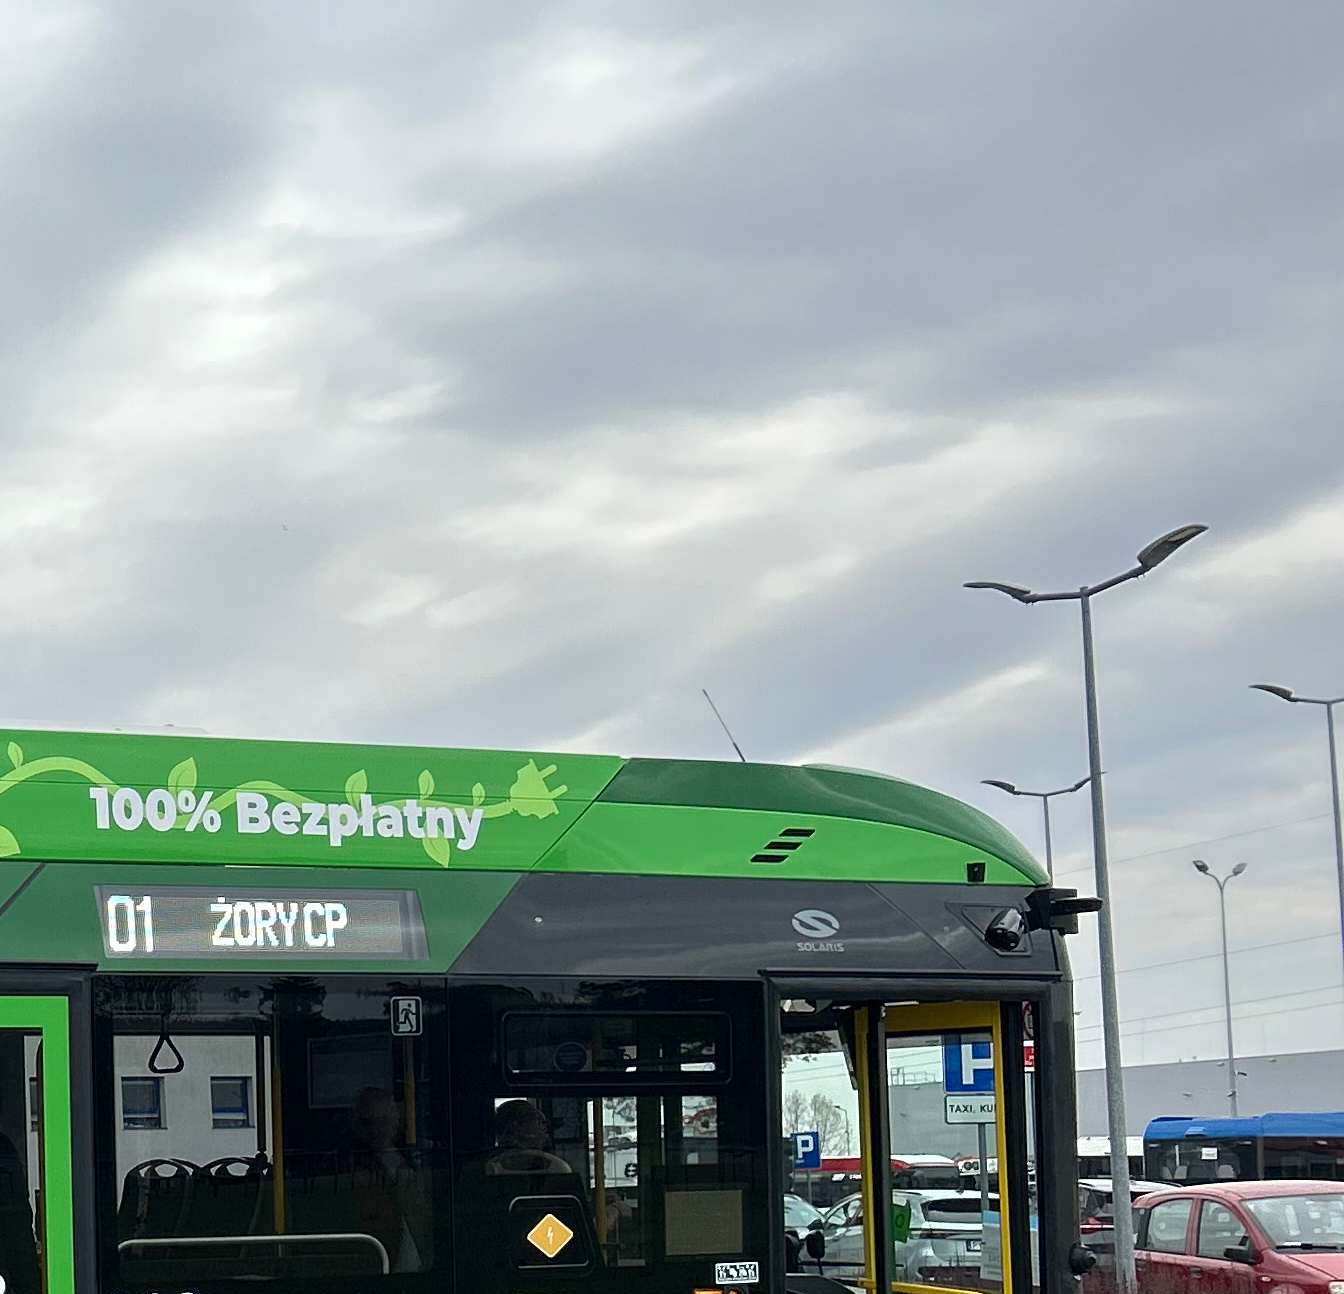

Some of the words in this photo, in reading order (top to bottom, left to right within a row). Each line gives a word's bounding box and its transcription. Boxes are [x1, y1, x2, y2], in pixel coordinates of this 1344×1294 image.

[89, 787, 221, 833] 100%
[236, 792, 484, 851] Bezpłatny
[107, 895, 153, 953] 01
[210, 896, 298, 947] ŻORY
[303, 902, 348, 948] CP
[797, 942, 845, 952] SOLARIS
[980, 1104, 997, 1113] KU
[796, 1135, 814, 1158] P
